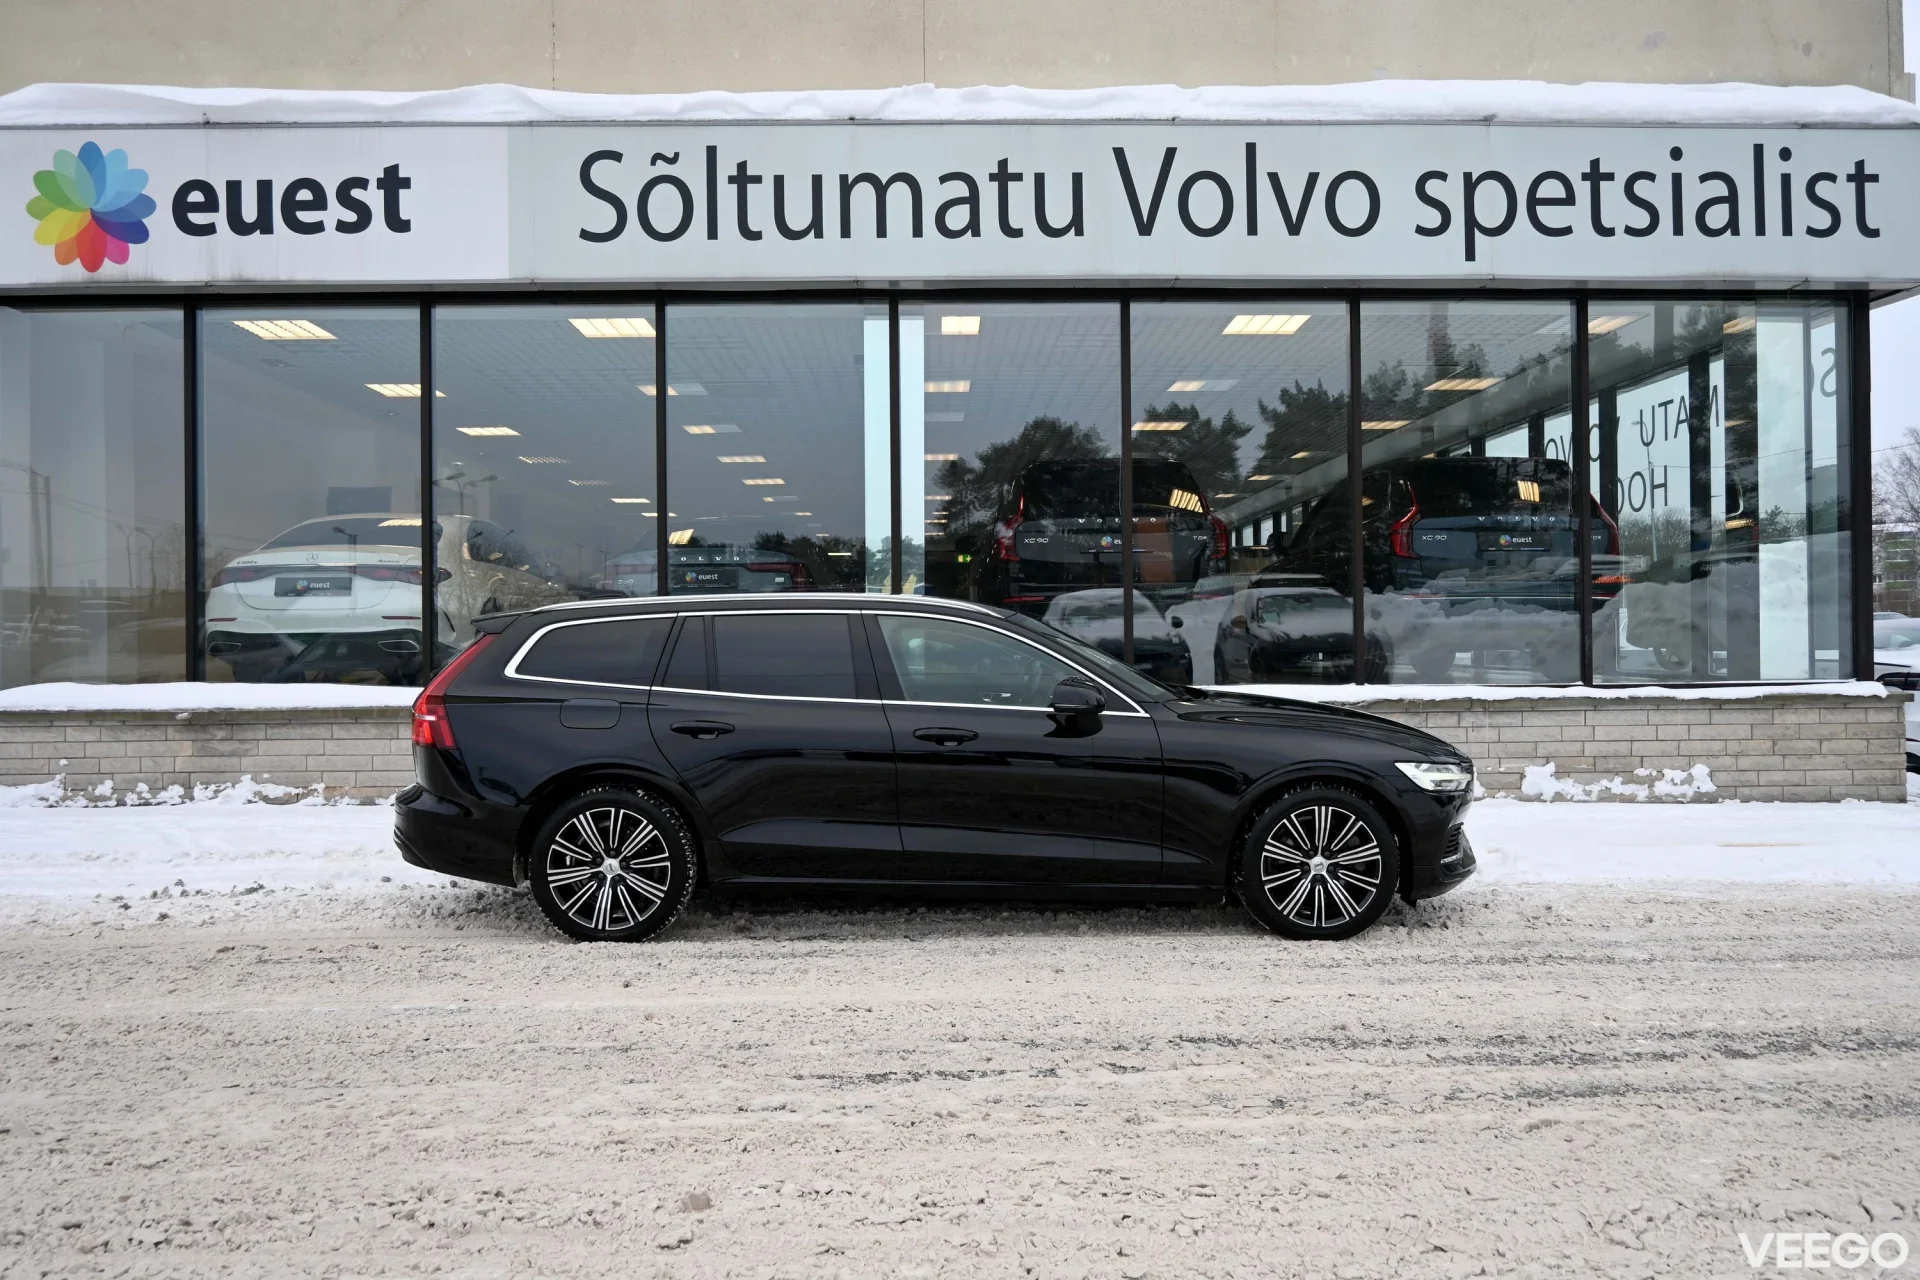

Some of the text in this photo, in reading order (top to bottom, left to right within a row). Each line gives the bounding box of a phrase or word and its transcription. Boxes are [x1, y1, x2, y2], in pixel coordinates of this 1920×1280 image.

[172, 164, 411, 237] euest
[579, 143, 1881, 262] Sõltumatu Volvo spetsialist
